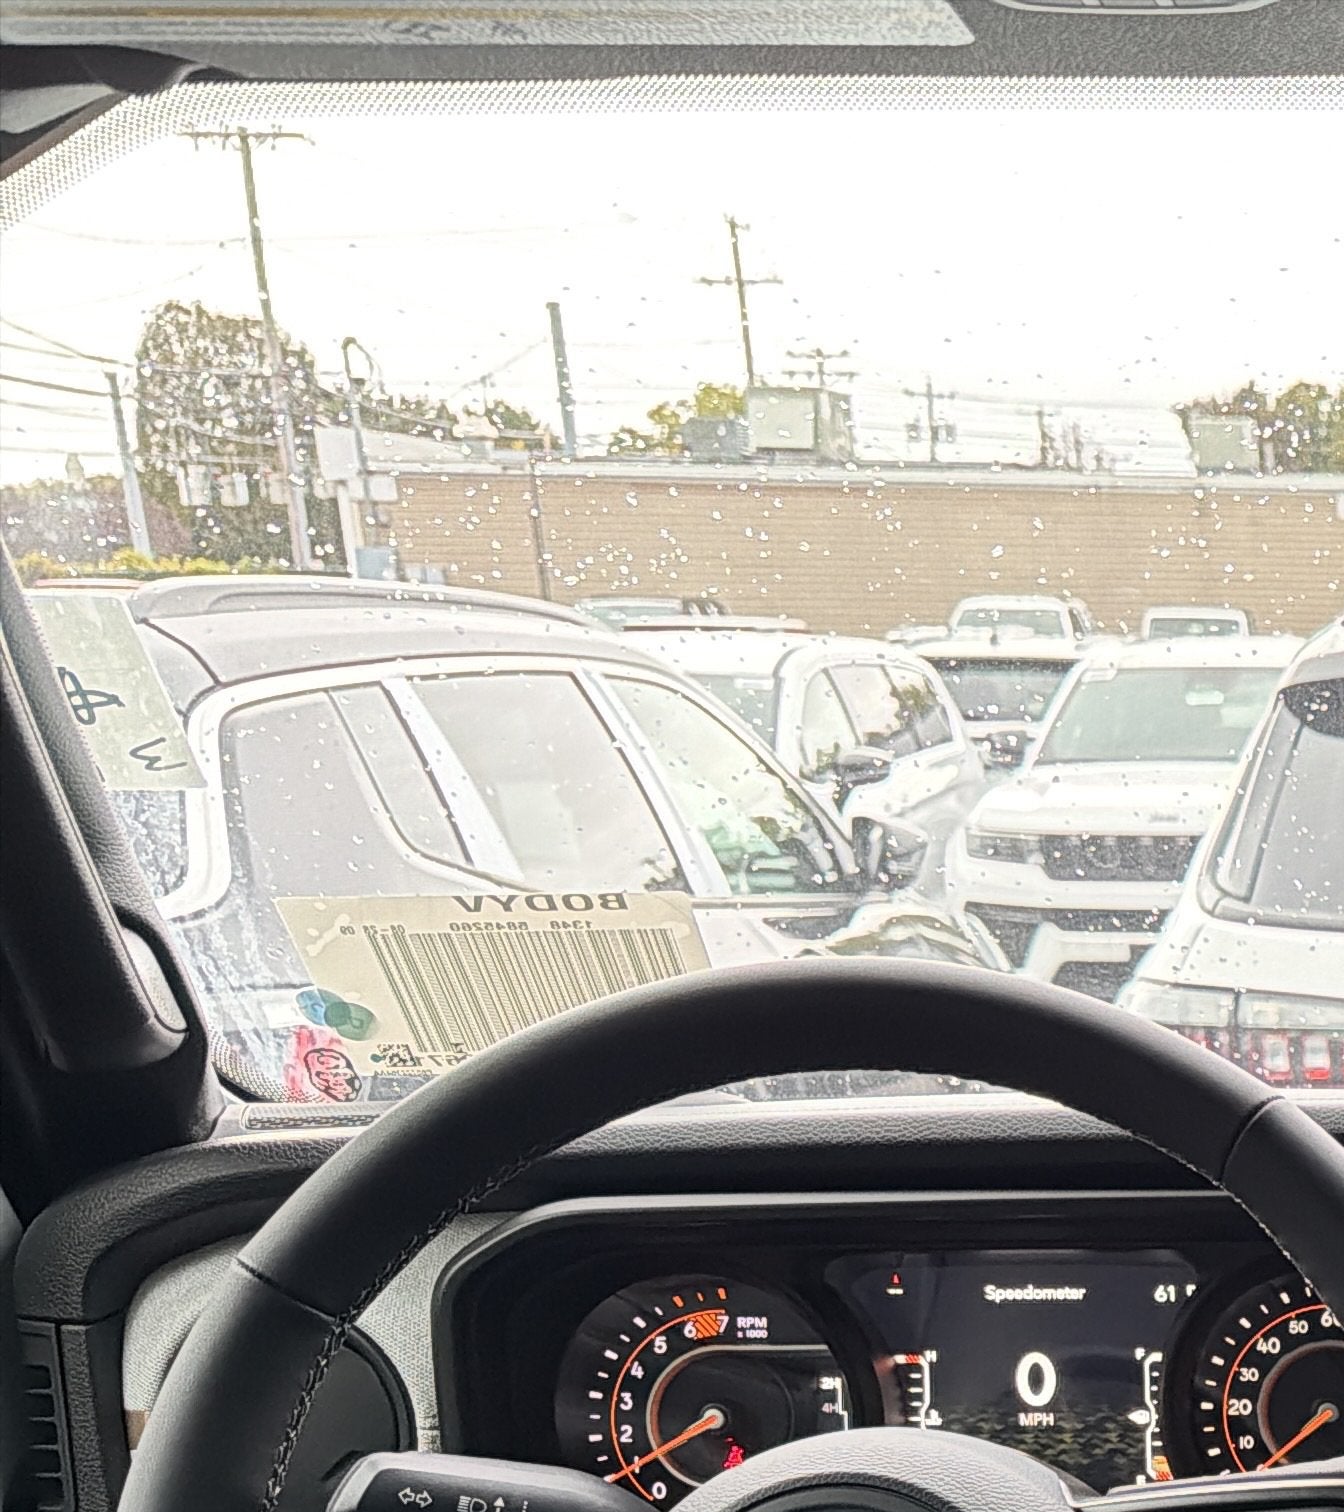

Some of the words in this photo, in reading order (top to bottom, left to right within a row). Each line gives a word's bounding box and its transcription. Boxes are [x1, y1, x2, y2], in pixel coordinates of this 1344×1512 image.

[983, 1284, 1087, 1303] Speedometer
[1153, 1284, 1176, 1302] 61
[737, 1316, 768, 1329] RPM
[1288, 1320, 1309, 1334] 50
[653, 1335, 667, 1354] 5
[1256, 1337, 1281, 1354] 40
[630, 1361, 645, 1379] 4
[1015, 1351, 1057, 1407] 0
[1239, 1367, 1259, 1382] 30
[620, 1393, 633, 1411] 3
[1228, 1399, 1252, 1415] 20
[1018, 1412, 1056, 1427] MPH
[620, 1424, 633, 1443] 2
[1238, 1435, 1255, 1449] 10
[651, 1482, 667, 1500] 0
